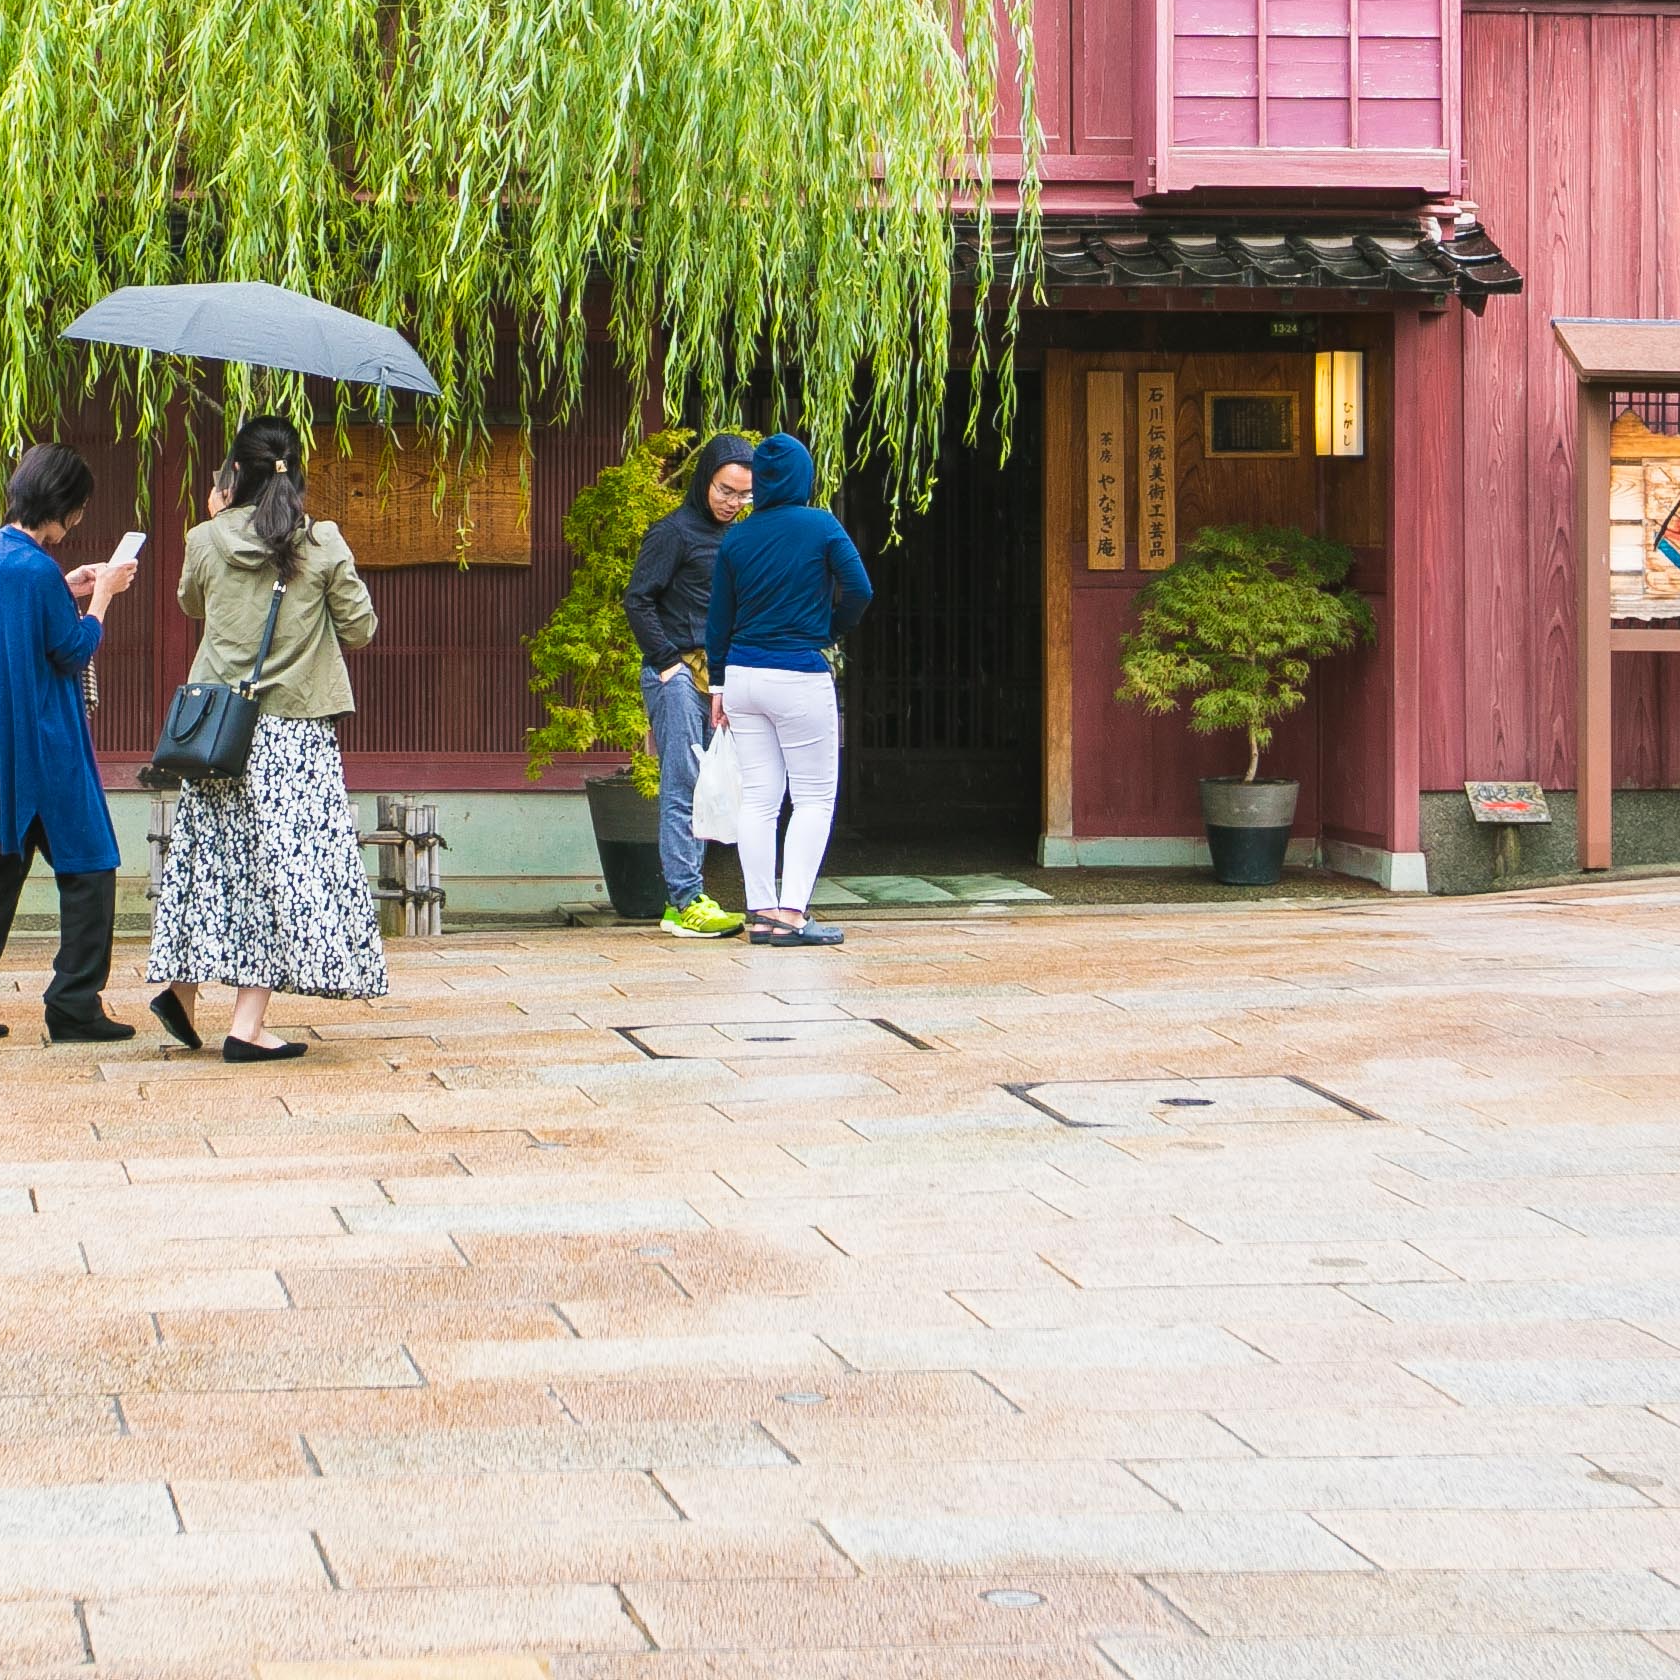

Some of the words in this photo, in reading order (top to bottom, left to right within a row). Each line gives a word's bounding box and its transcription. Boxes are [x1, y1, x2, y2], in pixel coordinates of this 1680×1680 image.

[1099, 432, 1113, 463] 茶房
[1343, 401, 1354, 447] ひがし
[1148, 387, 1166, 558] 石川伝統美術工芸品
[1097, 473, 1116, 557] やなぎ庵
